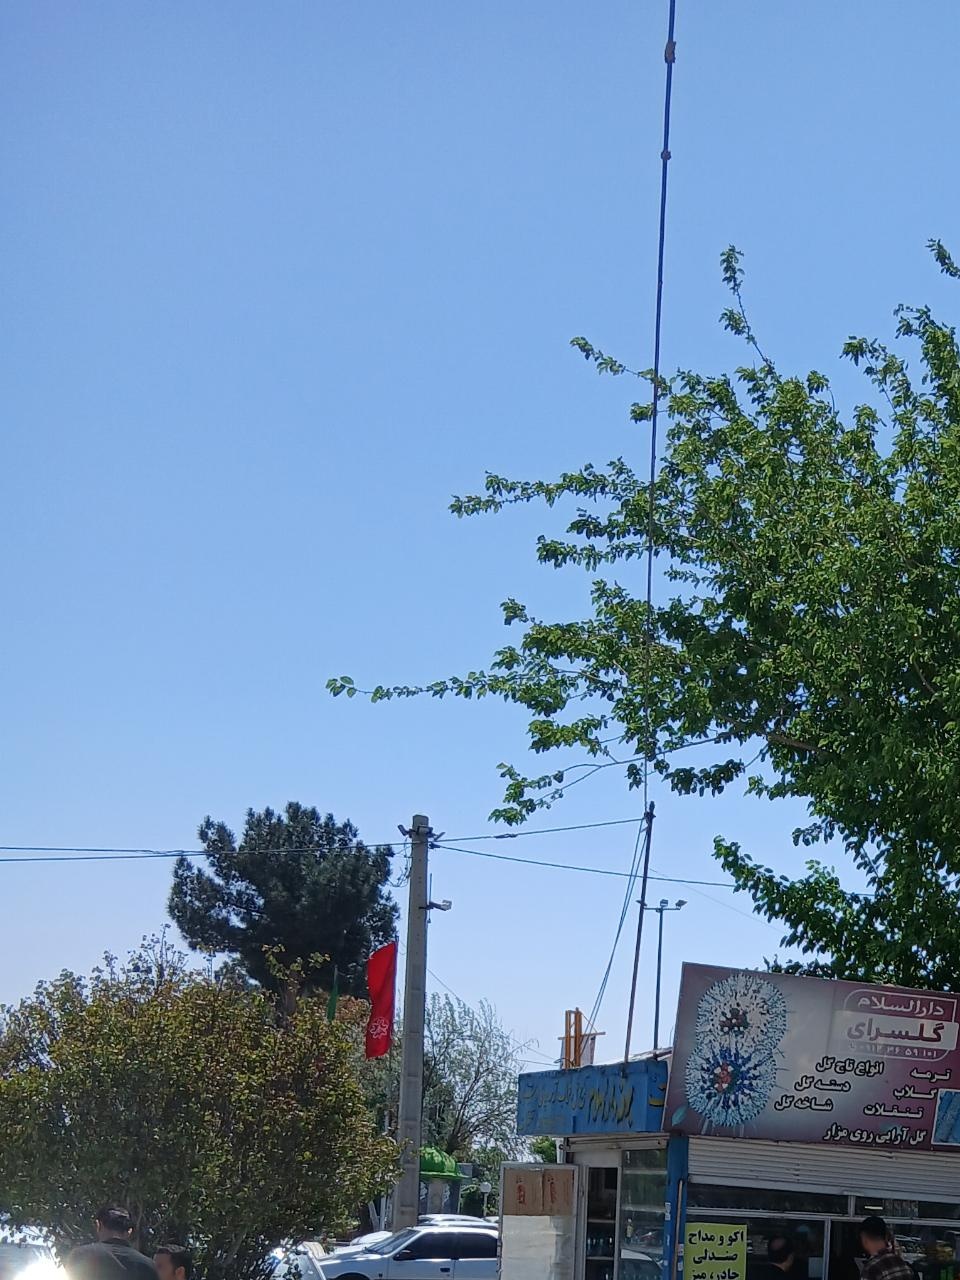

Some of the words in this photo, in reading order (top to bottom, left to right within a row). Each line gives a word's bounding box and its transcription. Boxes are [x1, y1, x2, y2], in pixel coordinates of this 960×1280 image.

[857, 996, 944, 1017] دارالسلام
[847, 1018, 945, 1042] گلسرای
[815, 1056, 835, 1073] گل
[834, 1058, 854, 1075] تاج
[855, 1061, 885, 1077] انواع
[910, 1067, 951, 1082] ترمه
[794, 1076, 814, 1092] گل
[814, 1079, 851, 1092] دسته
[774, 1094, 794, 1111] گل
[794, 1096, 834, 1111] شاخه
[863, 1103, 924, 1119] تنقلات
[823, 1122, 848, 1141] مزار
[849, 1130, 874, 1143] روی
[875, 1127, 910, 1146] آرایی
[909, 1130, 927, 1146] گل
[688, 1230, 715, 1244] مداح
[718, 1236, 724, 1246] و
[727, 1230, 744, 1246] اکو
[693, 1248, 738, 1264] صندلی
